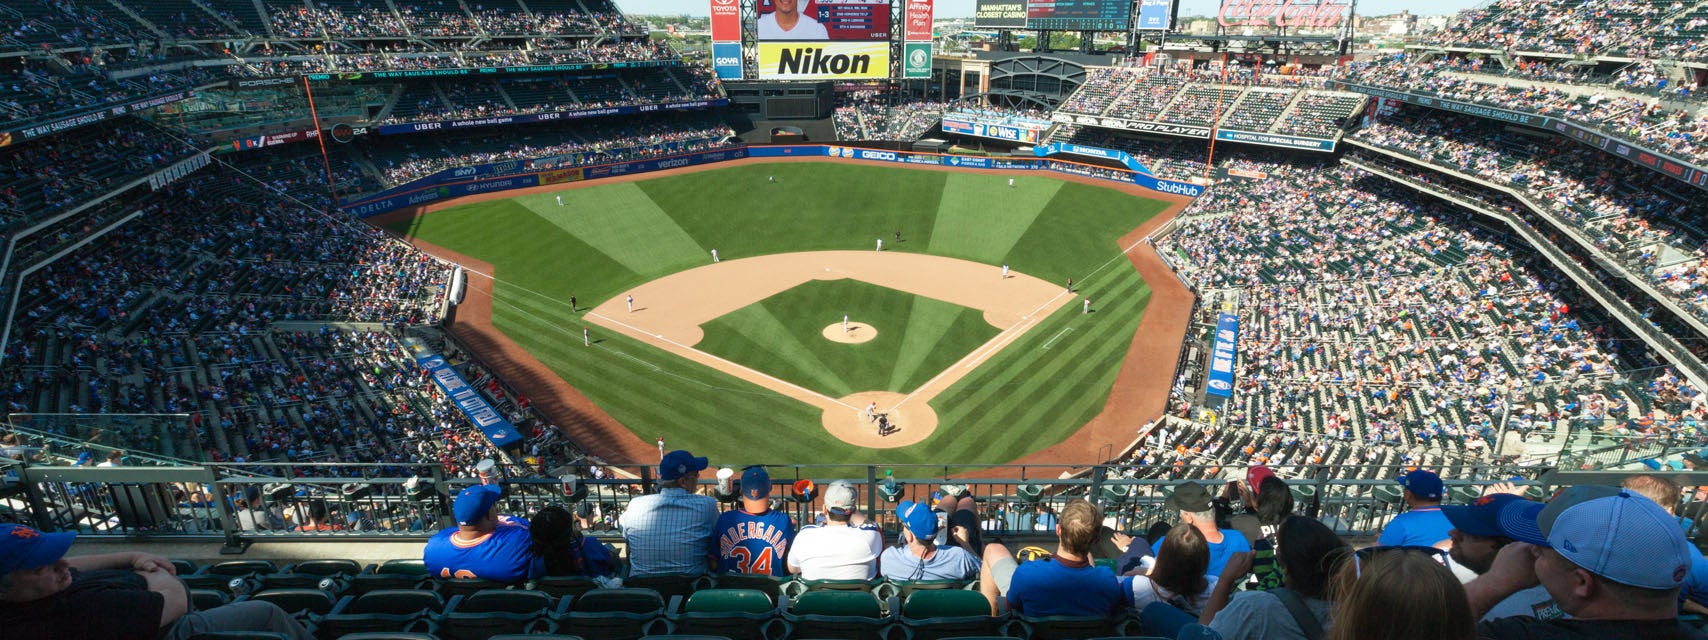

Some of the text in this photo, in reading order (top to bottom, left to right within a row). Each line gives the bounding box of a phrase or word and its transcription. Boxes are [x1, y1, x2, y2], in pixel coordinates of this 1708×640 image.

[909, 4, 931, 12] Affinity
[778, 48, 870, 76] Nikon
[240, 77, 295, 87] PORSCHE
[1450, 103, 1464, 112] WAY
[1464, 105, 1491, 117] SAUSAGE
[1492, 109, 1518, 122] SHOULD
[22, 128, 36, 138] THE
[36, 125, 50, 136] WAY
[50, 118, 78, 132] SAUSAGE
[77, 114, 98, 126] SHOULD
[414, 122, 442, 131] UBER
[1126, 121, 1210, 136] PRO PLAYER
[352, 128, 368, 136] 24
[997, 127, 1018, 138] WISE
[1234, 134, 1258, 142] HOSPITAL
[1269, 137, 1293, 145] SPECIAL
[1293, 139, 1322, 148] SURGERY
[862, 150, 896, 161] GEICO
[1080, 148, 1107, 156] HONDA
[658, 158, 688, 168] verizon
[480, 180, 512, 190] HYUNDAI
[1157, 181, 1198, 196] StubHub
[360, 200, 393, 214] DELTA
[730, 546, 772, 576] 34
